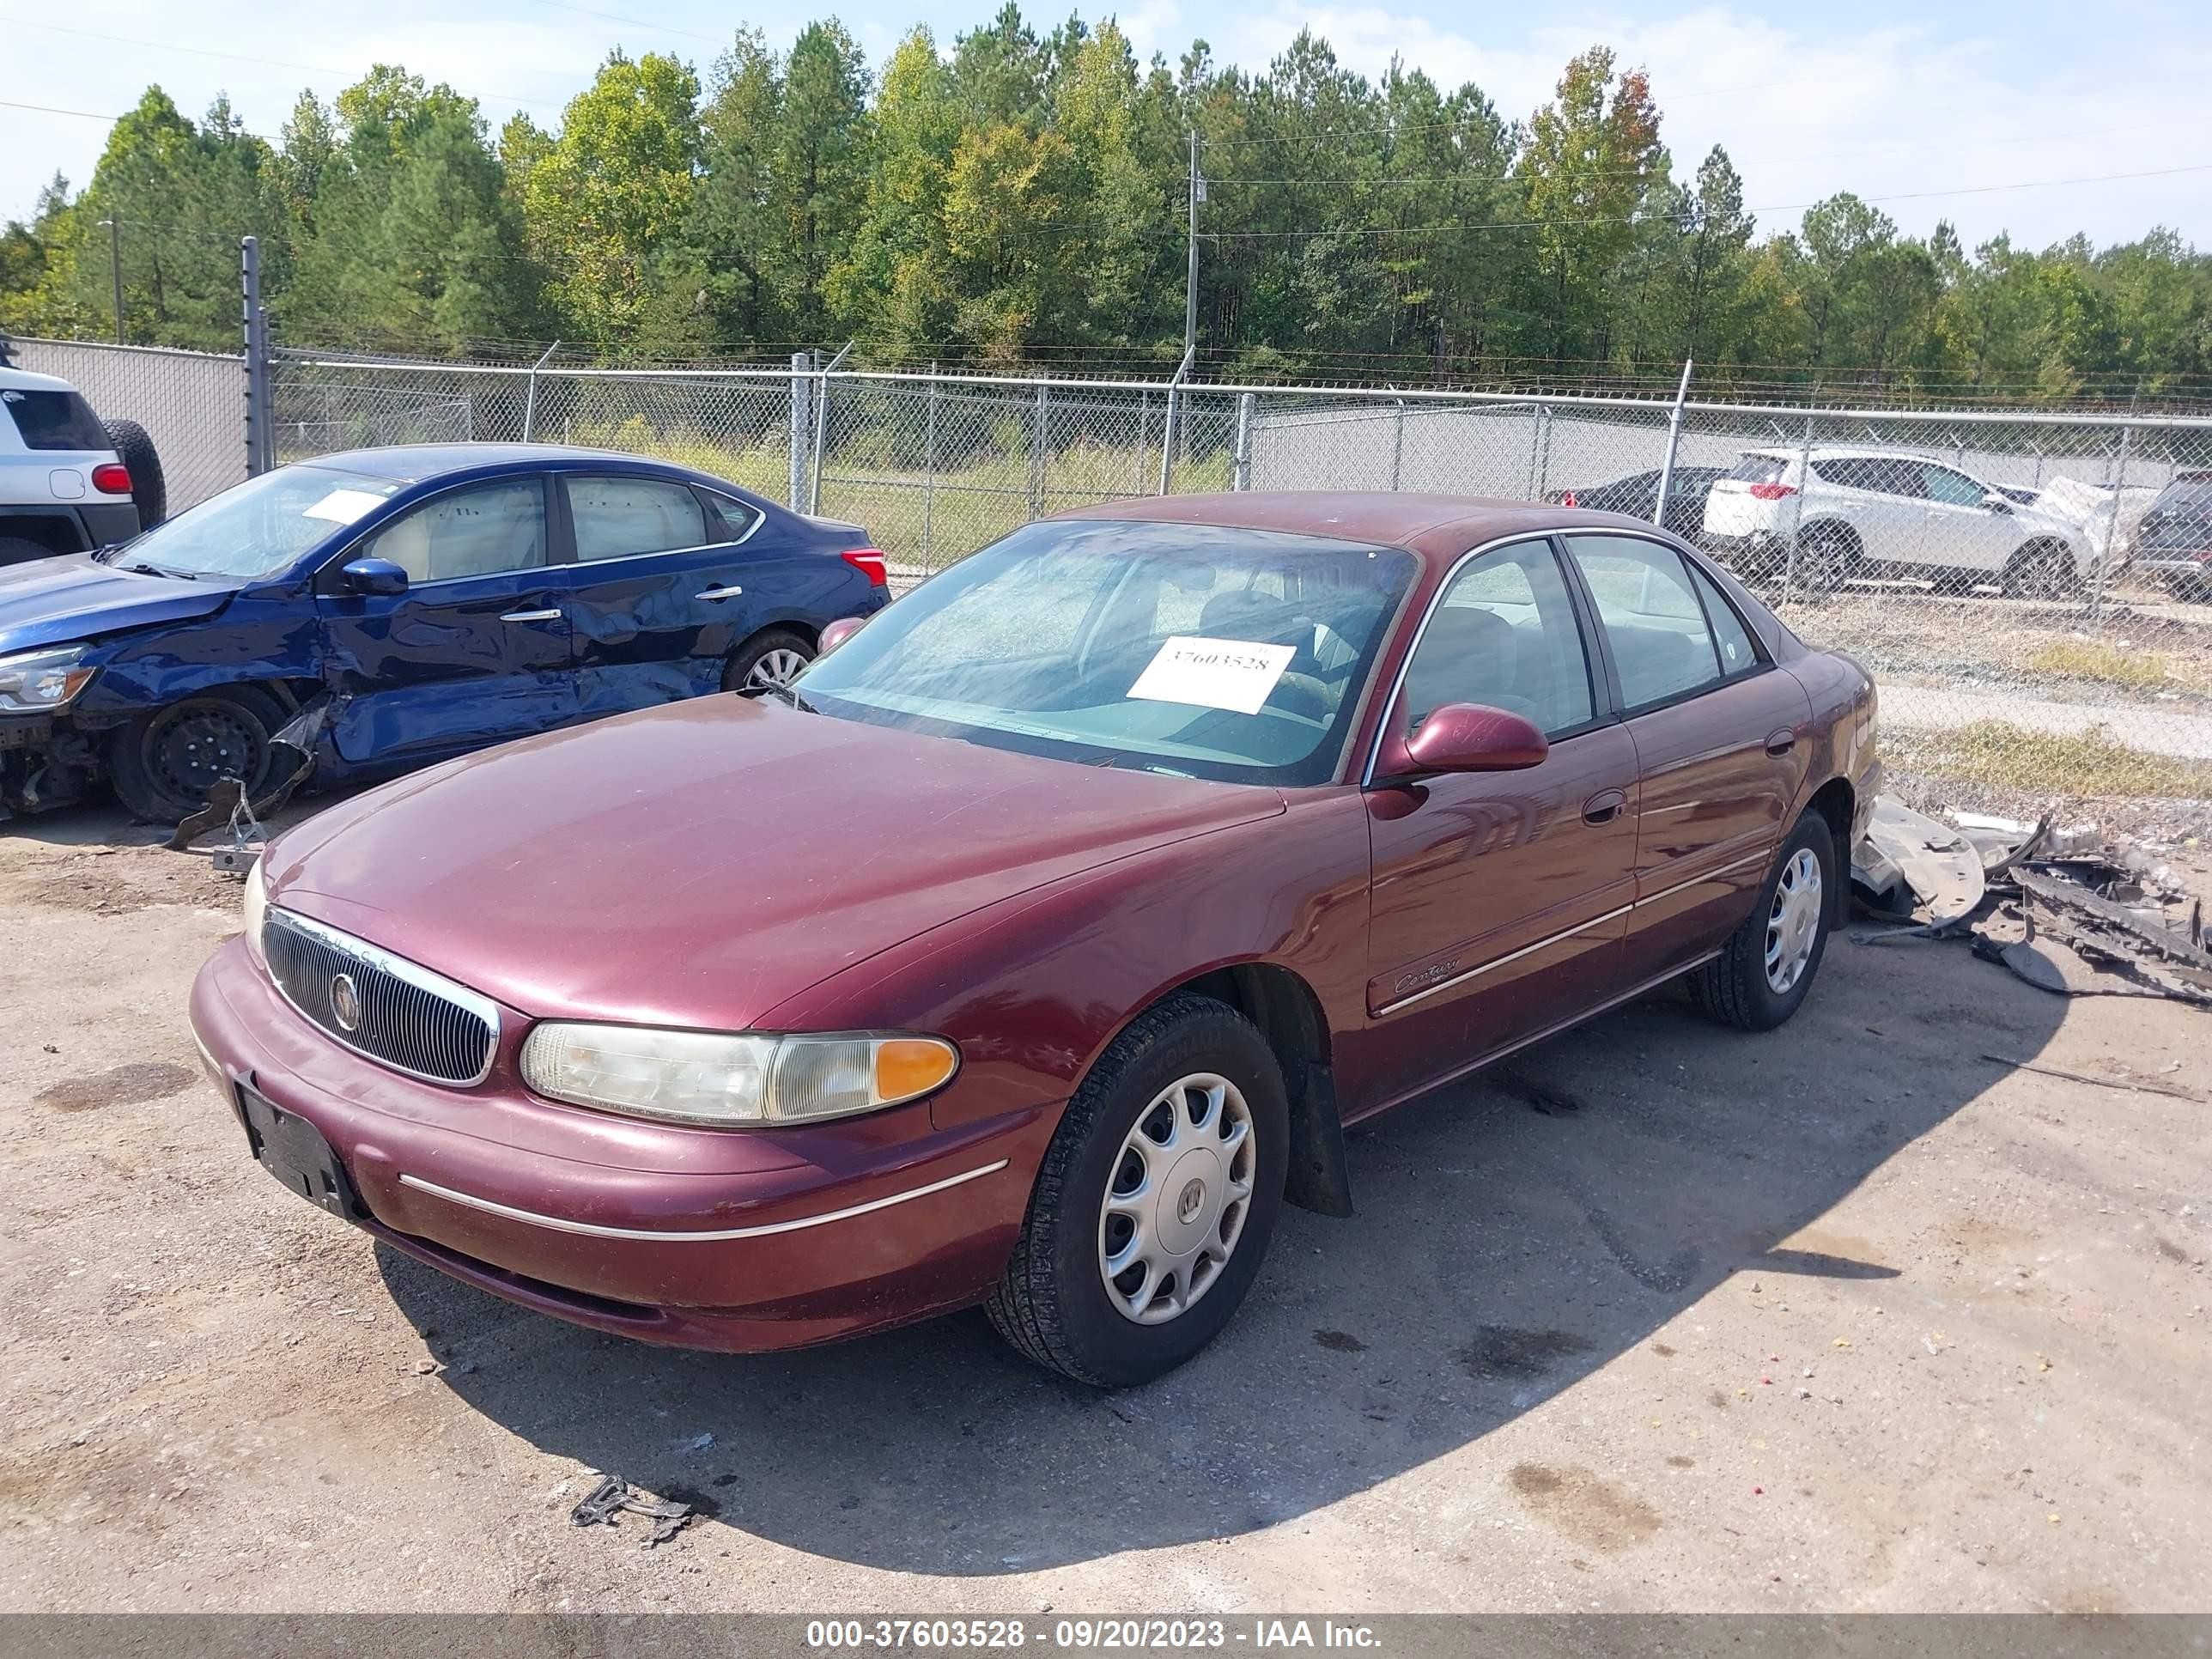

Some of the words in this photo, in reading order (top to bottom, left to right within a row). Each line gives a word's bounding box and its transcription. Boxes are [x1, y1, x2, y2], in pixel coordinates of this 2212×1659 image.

[1166, 651, 1270, 670] 37603528
[319, 932, 391, 972] BUICK
[1395, 958, 1461, 994] Century
